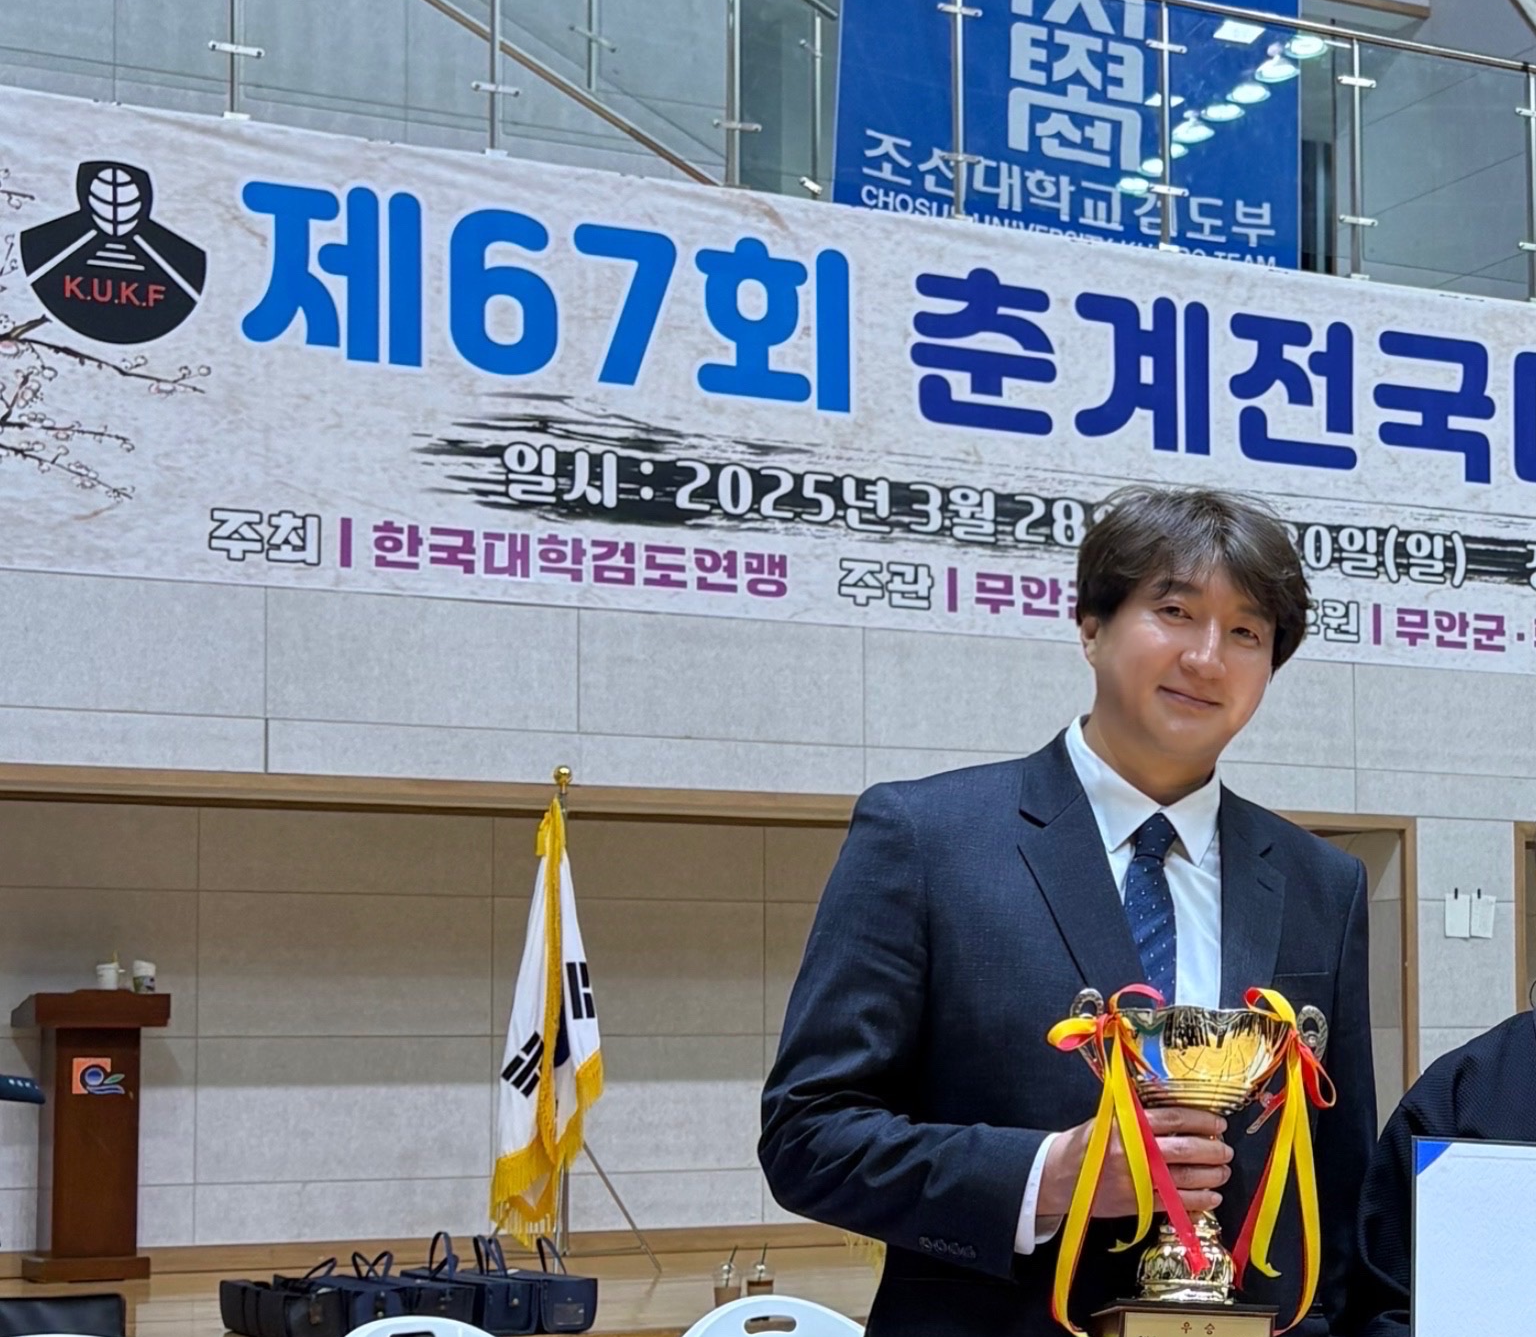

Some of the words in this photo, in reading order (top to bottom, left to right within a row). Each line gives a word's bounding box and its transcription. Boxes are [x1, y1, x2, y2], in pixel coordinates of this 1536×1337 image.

[62, 273, 167, 309] K.U.K.F
[241, 177, 852, 413] 제67회
[502, 441, 619, 509] 일시
[674, 459, 894, 535] 2025년
[906, 482, 999, 545] 3월
[208, 506, 322, 566] 주최
[370, 518, 790, 598] 한국대학검도연맹
[839, 556, 935, 612] 주관
[1292, 520, 1467, 587] 0일(일)
